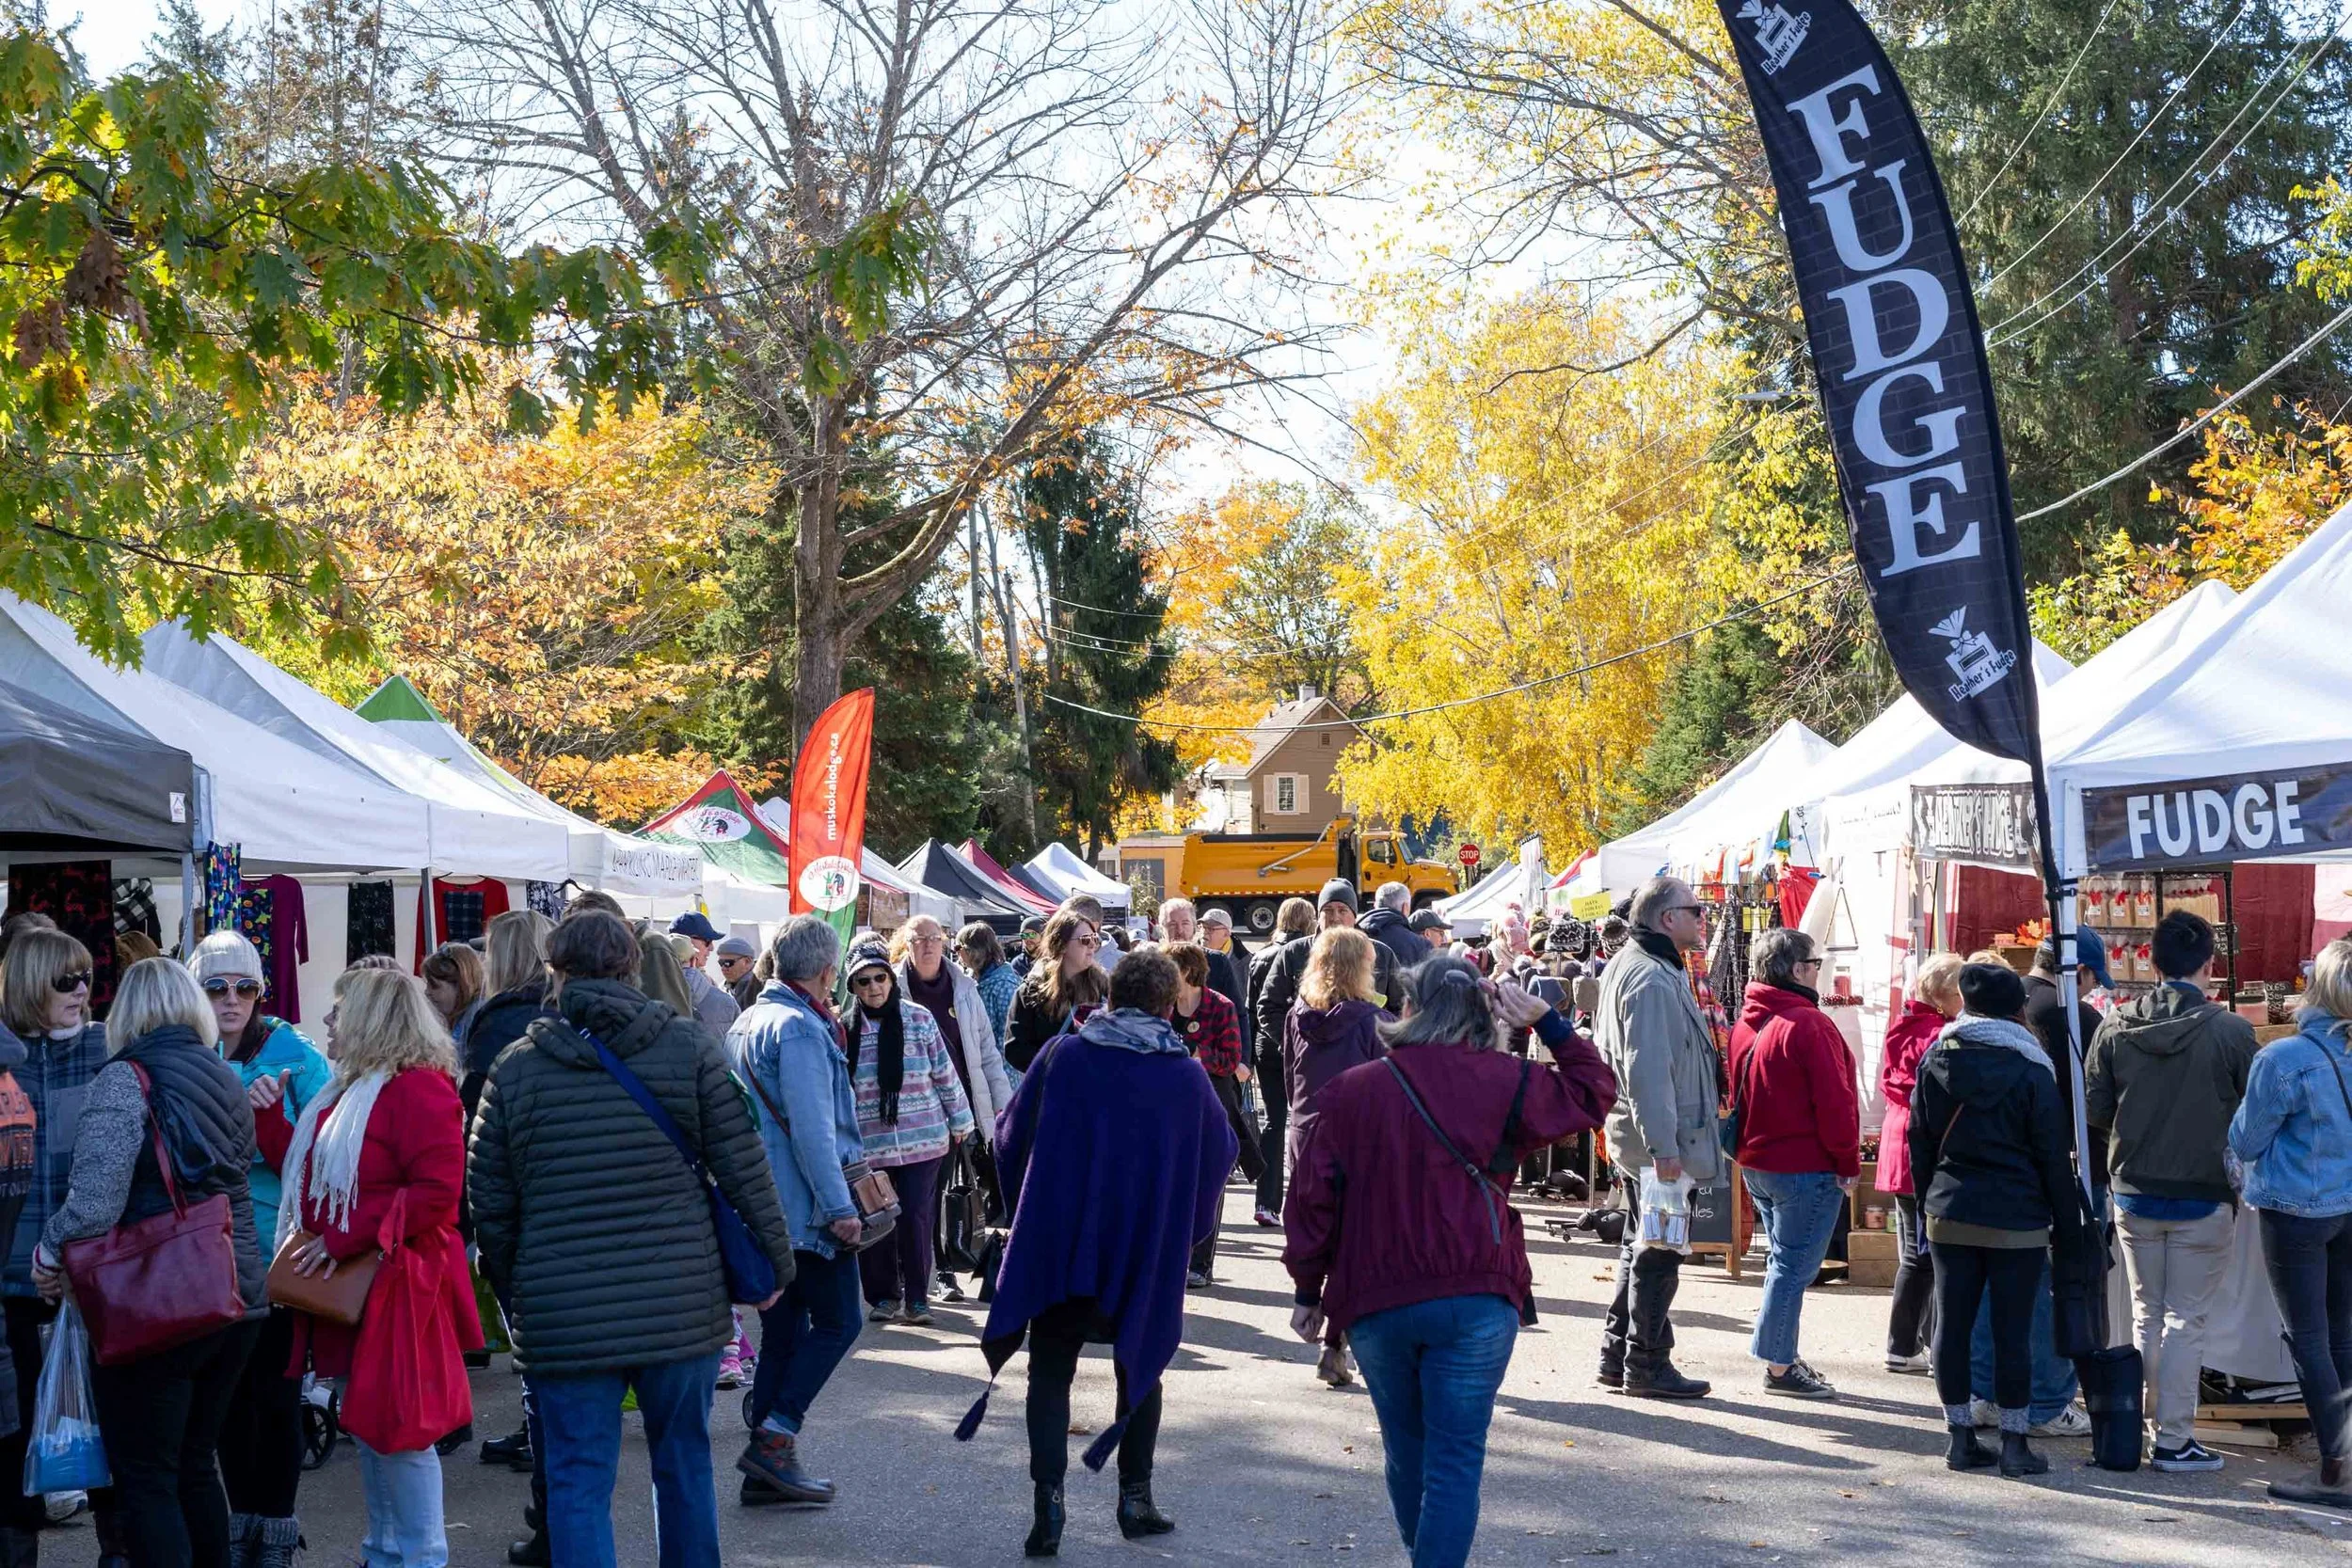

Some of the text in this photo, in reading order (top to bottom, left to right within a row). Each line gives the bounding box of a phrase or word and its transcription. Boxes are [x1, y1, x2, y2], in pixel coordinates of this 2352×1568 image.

[1762, 12, 1810, 73] Heather's Fudge
[1786, 63, 1980, 578] FUDGE
[1950, 650, 2015, 700] Heather's Fudge
[824, 732, 843, 841] muskokalodge.ca
[2126, 781, 2305, 860] FUDGE
[1460, 850, 1479, 860] STOP
